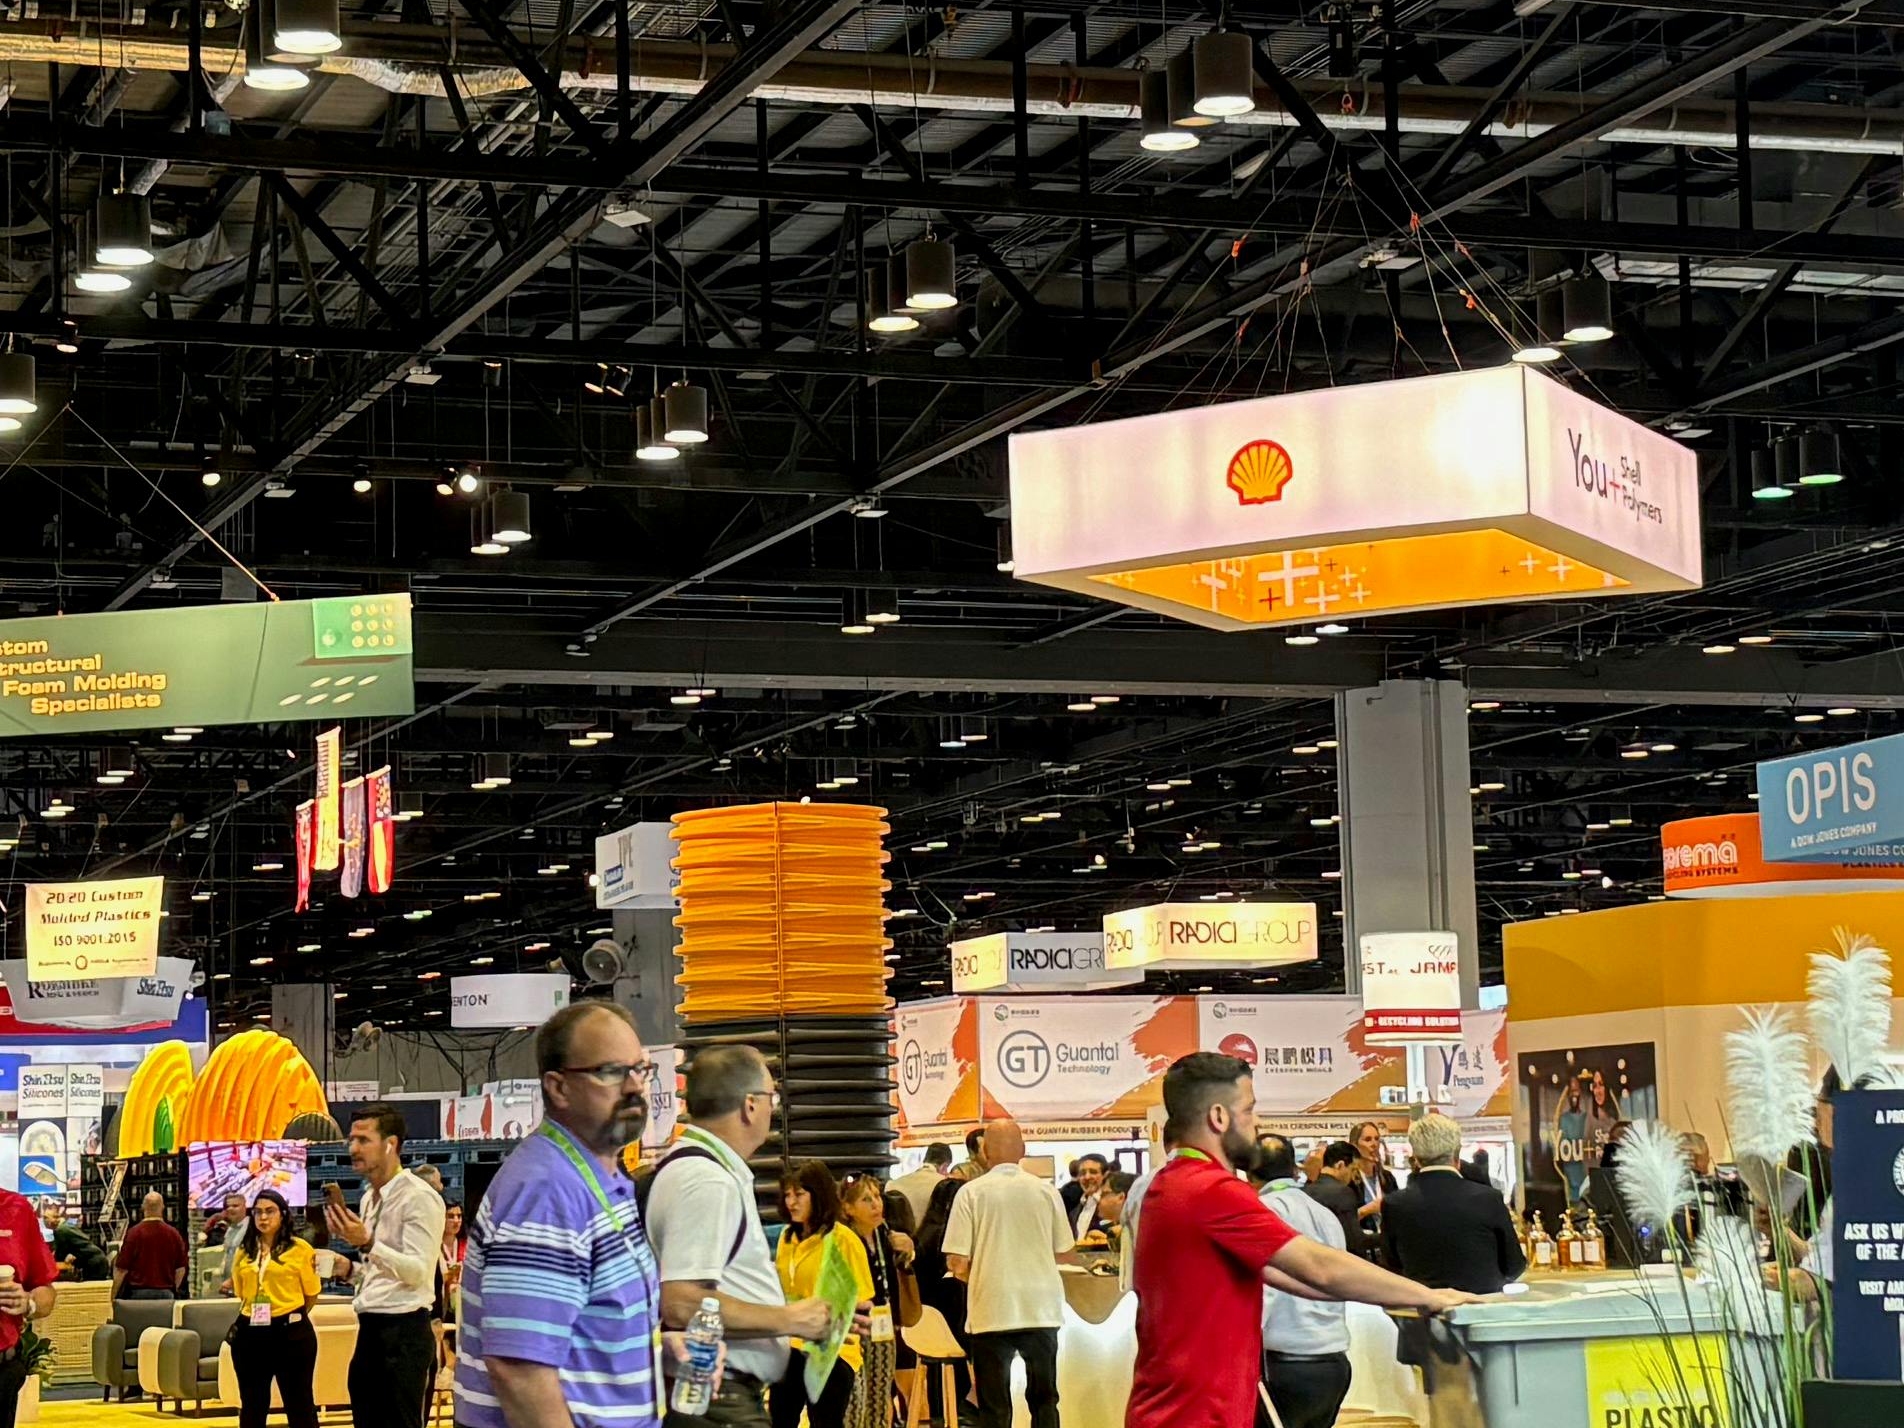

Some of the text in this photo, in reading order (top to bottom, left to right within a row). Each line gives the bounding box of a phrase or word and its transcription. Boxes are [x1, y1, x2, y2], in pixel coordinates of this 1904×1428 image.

[3, 672, 167, 696] Foam Molding
[31, 693, 161, 716] Specialists
[1786, 752, 1876, 824] OPIS
[1815, 830, 1839, 845] JONES
[1840, 823, 1877, 839] COMPANY
[1853, 846, 1889, 856] JONES
[92, 890, 144, 902] Custom
[95, 910, 151, 923] Plastics
[1005, 1046, 1048, 1073] GT
[1056, 1042, 1119, 1062] Guantai
[1058, 1063, 1110, 1076] Technology
[22, 1088, 64, 1099] Silicones
[1875, 1110, 1885, 1124] A
[1844, 1223, 1869, 1239] ASK
[1872, 1223, 1889, 1239] US
[1856, 1243, 1873, 1260] OF
[1876, 1243, 1899, 1260] THE
